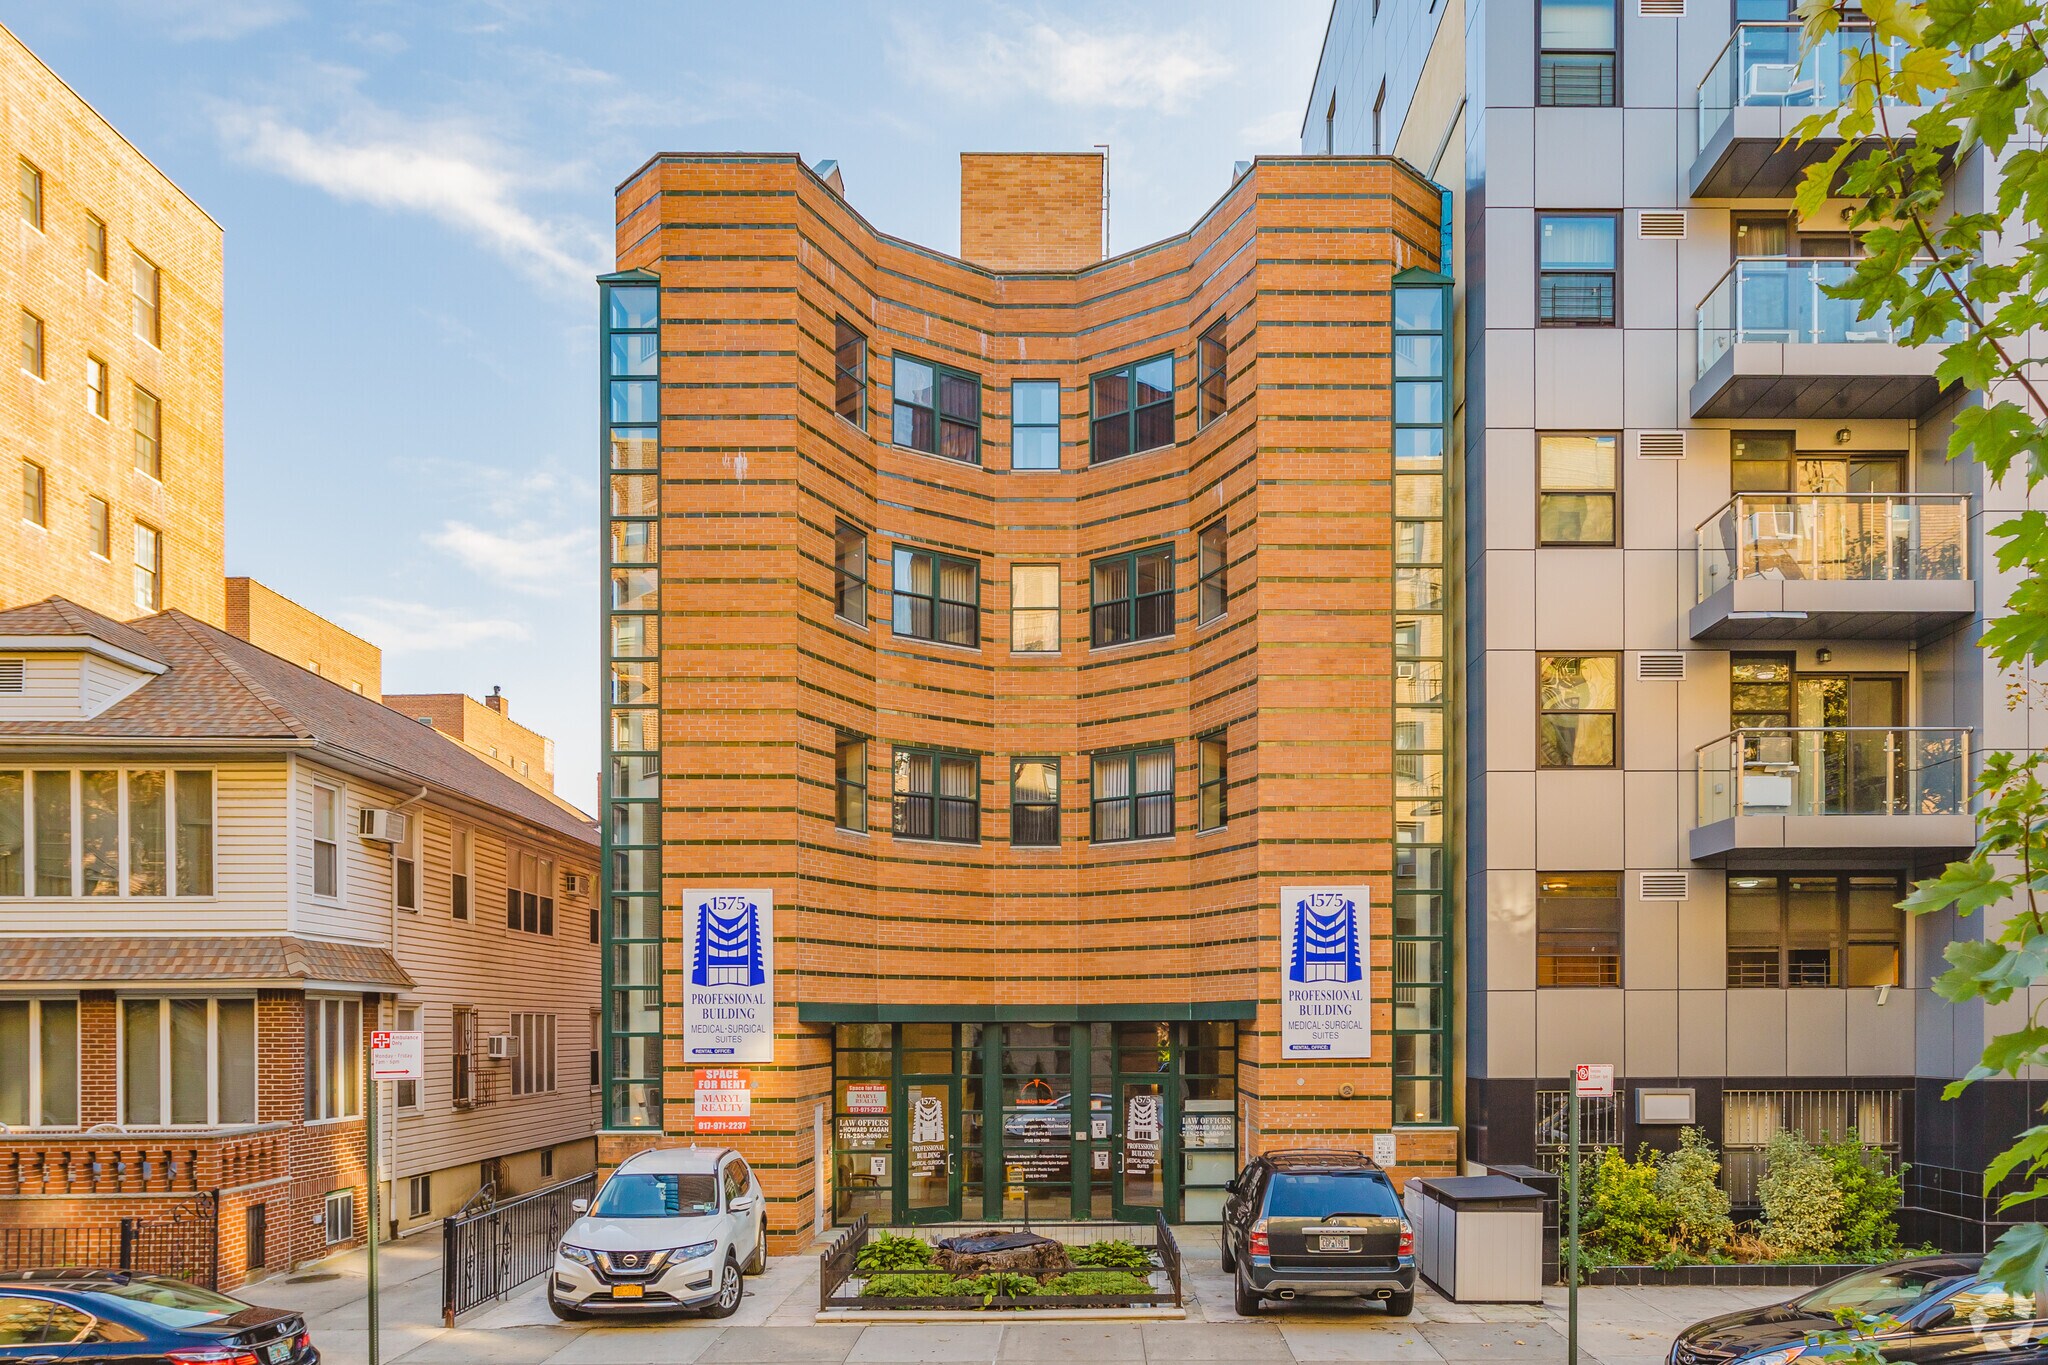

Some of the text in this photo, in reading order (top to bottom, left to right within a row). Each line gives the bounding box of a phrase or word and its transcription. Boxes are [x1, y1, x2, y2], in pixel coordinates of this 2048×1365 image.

[710, 896, 746, 910] 1575
[1308, 893, 1343, 907] 1575
[692, 993, 766, 1005] PROFESSIONAL
[1289, 989, 1363, 1001] PROFESSIONAL
[702, 1008, 755, 1020] BUILDING
[1300, 1004, 1352, 1016] BUILDING
[715, 1035, 742, 1043] SUITES
[1312, 1031, 1340, 1040] SUITES
[706, 1070, 739, 1079] SPACE
[698, 1080, 747, 1089] FOR RENT
[703, 1094, 741, 1102] MARYL
[1135, 1095, 1151, 1103] 1575
[701, 1103, 744, 1111] REALTY
[698, 1122, 748, 1130] 917-971-2237
